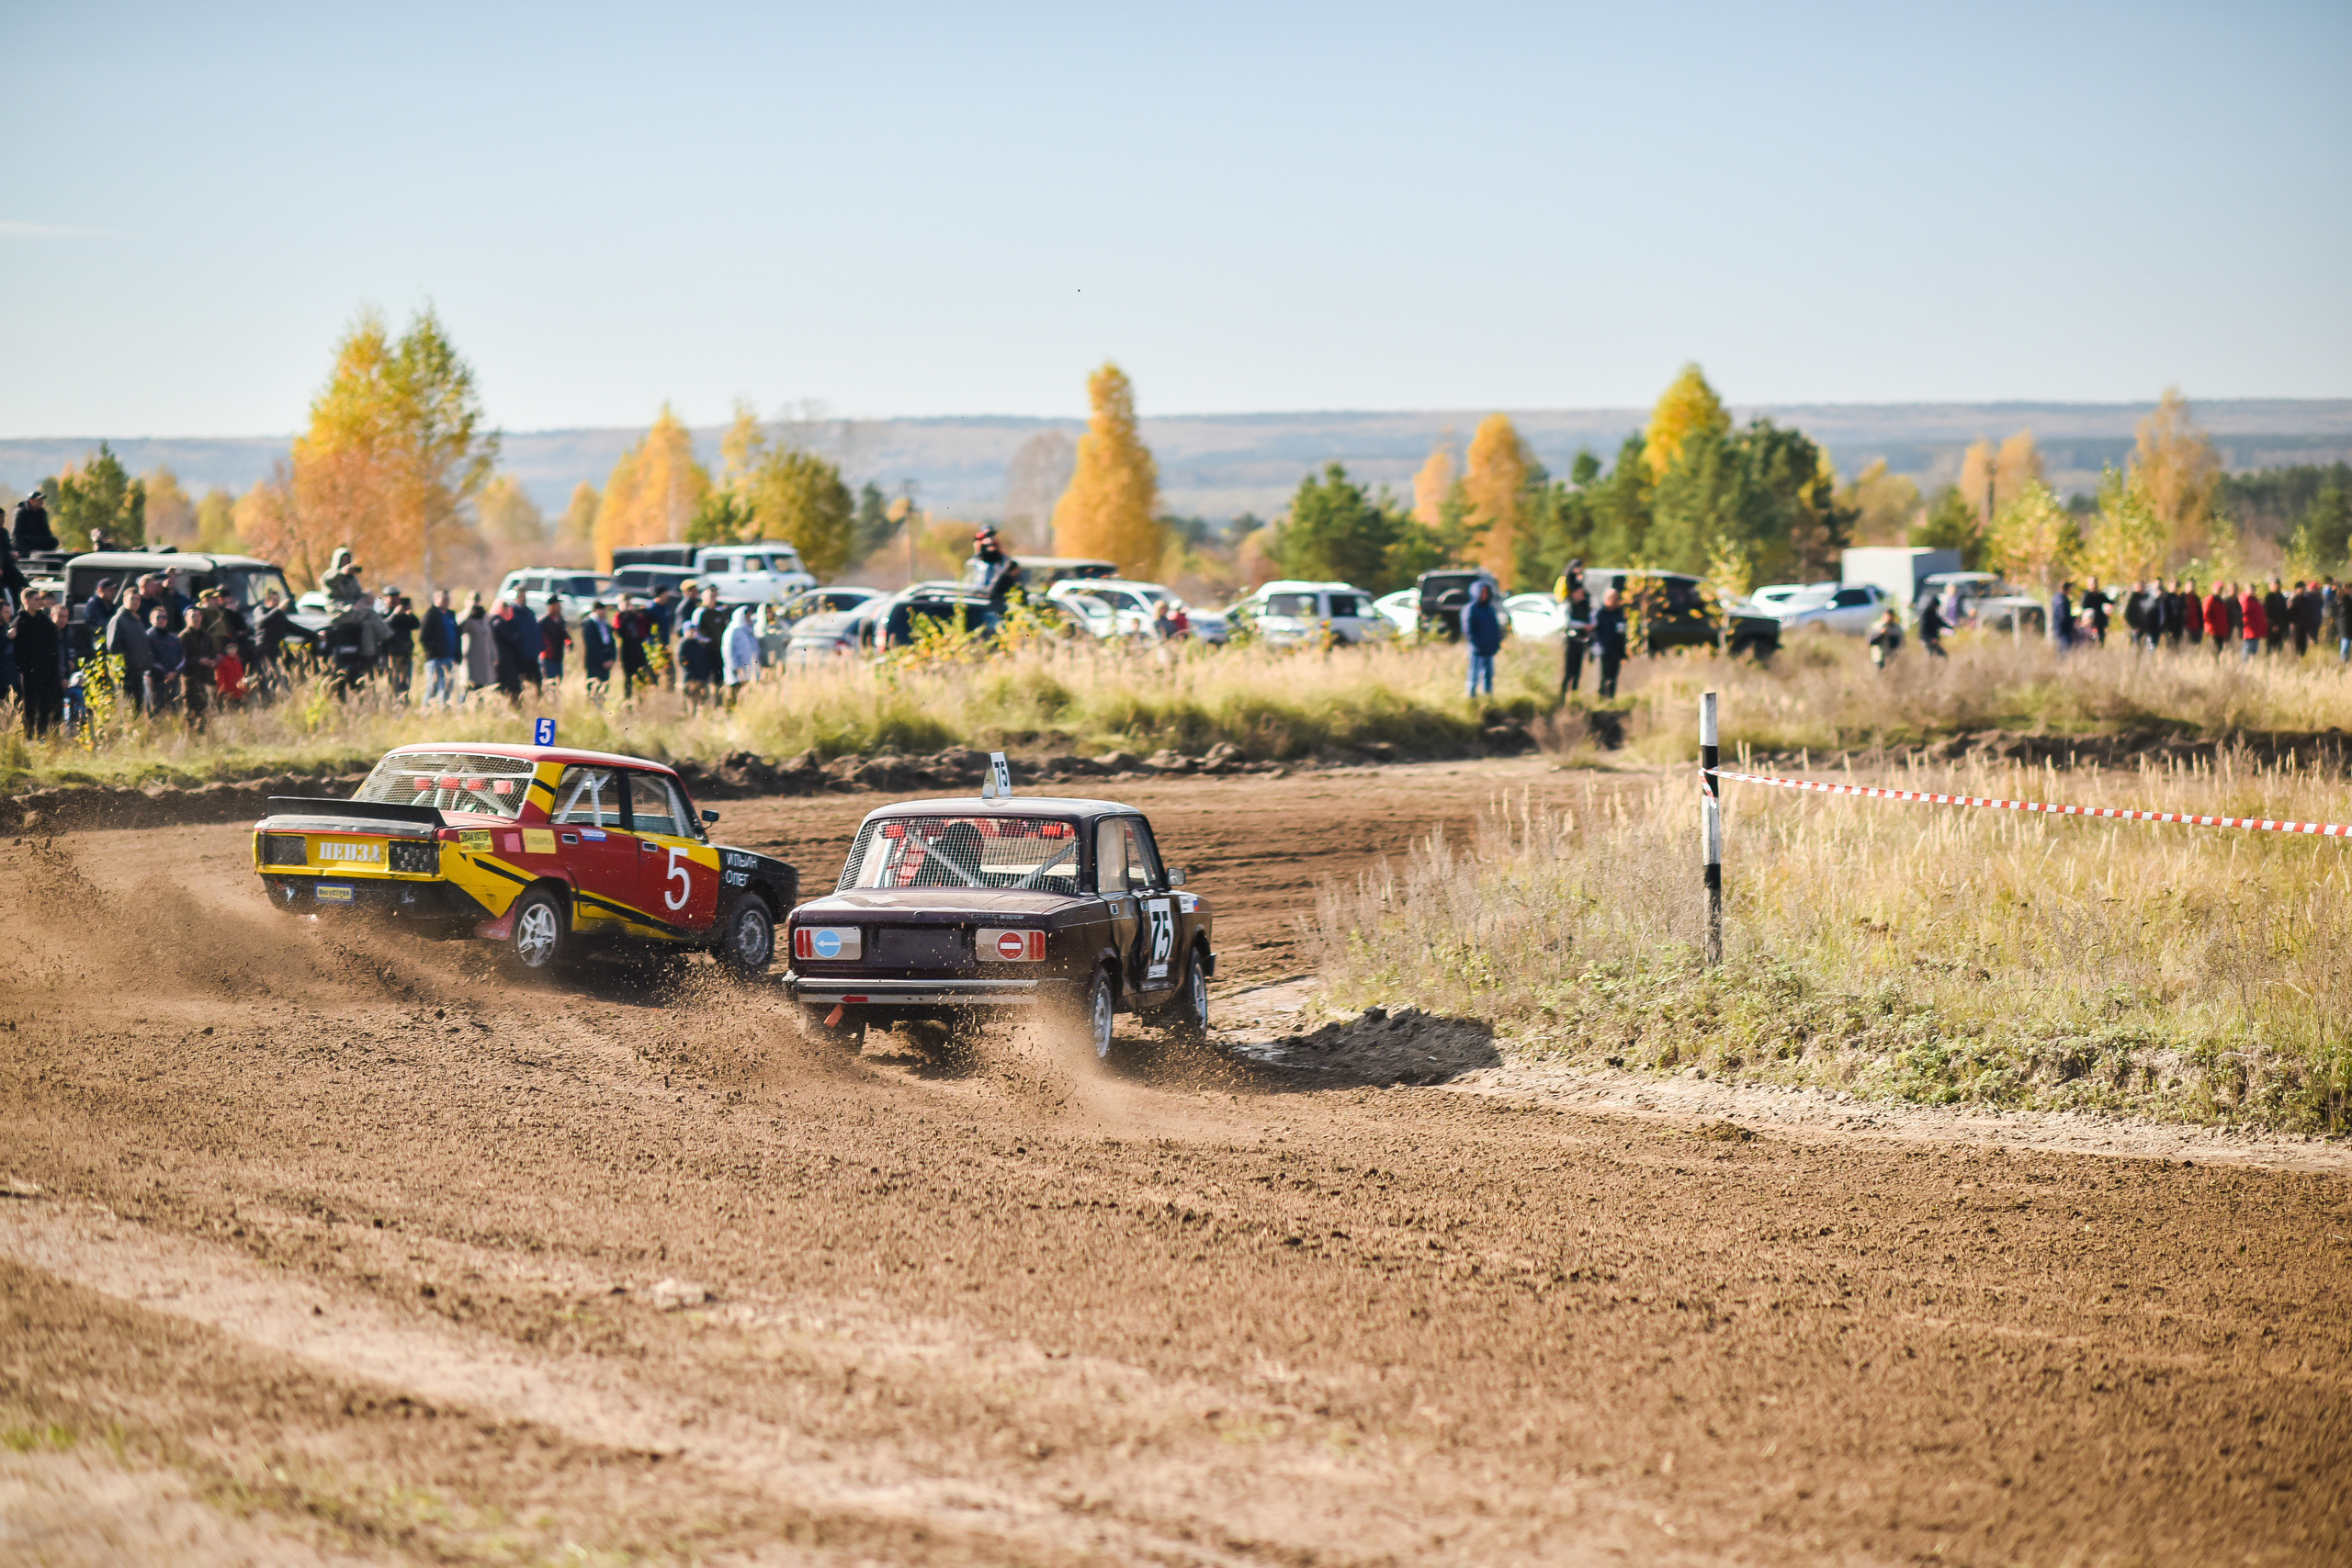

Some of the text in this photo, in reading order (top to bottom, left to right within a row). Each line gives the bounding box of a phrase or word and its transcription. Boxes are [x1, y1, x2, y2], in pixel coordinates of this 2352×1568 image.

[538, 719, 551, 744] 5
[994, 761, 1008, 787] 75
[319, 841, 380, 862] ПЕНЗА
[726, 852, 758, 869] ИЛЬИН
[664, 846, 690, 910] 5
[726, 869, 750, 886] ОЛЕГ
[1150, 910, 1170, 966] 75
